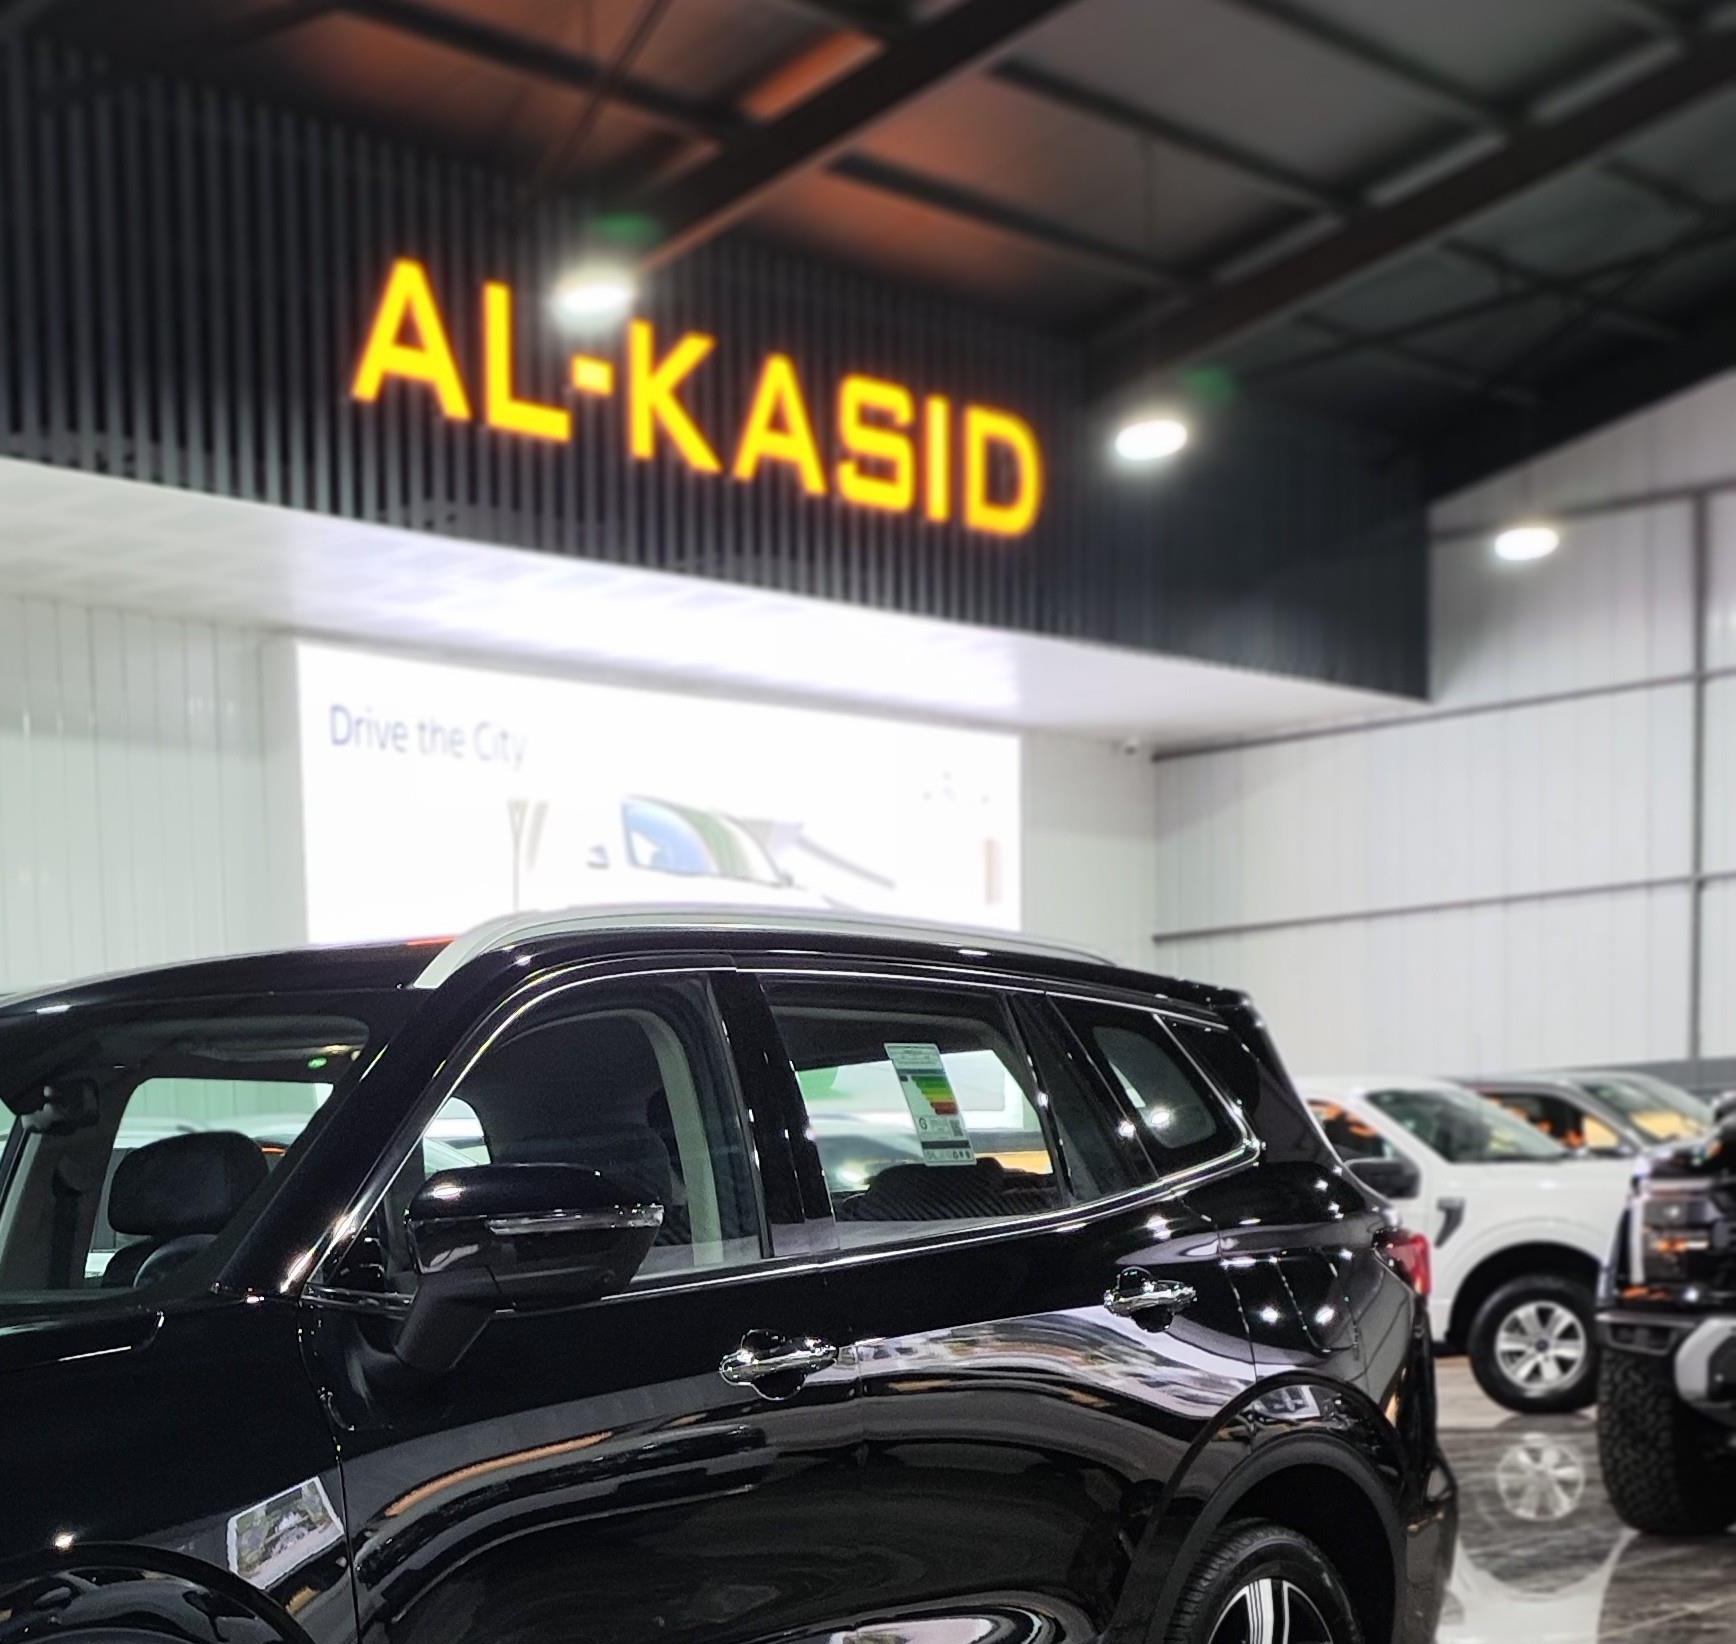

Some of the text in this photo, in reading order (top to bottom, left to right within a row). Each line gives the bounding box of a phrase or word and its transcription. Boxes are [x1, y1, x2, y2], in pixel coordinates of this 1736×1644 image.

[351, 256, 1045, 538] AL-KASID
[329, 702, 529, 772] Drive the City
